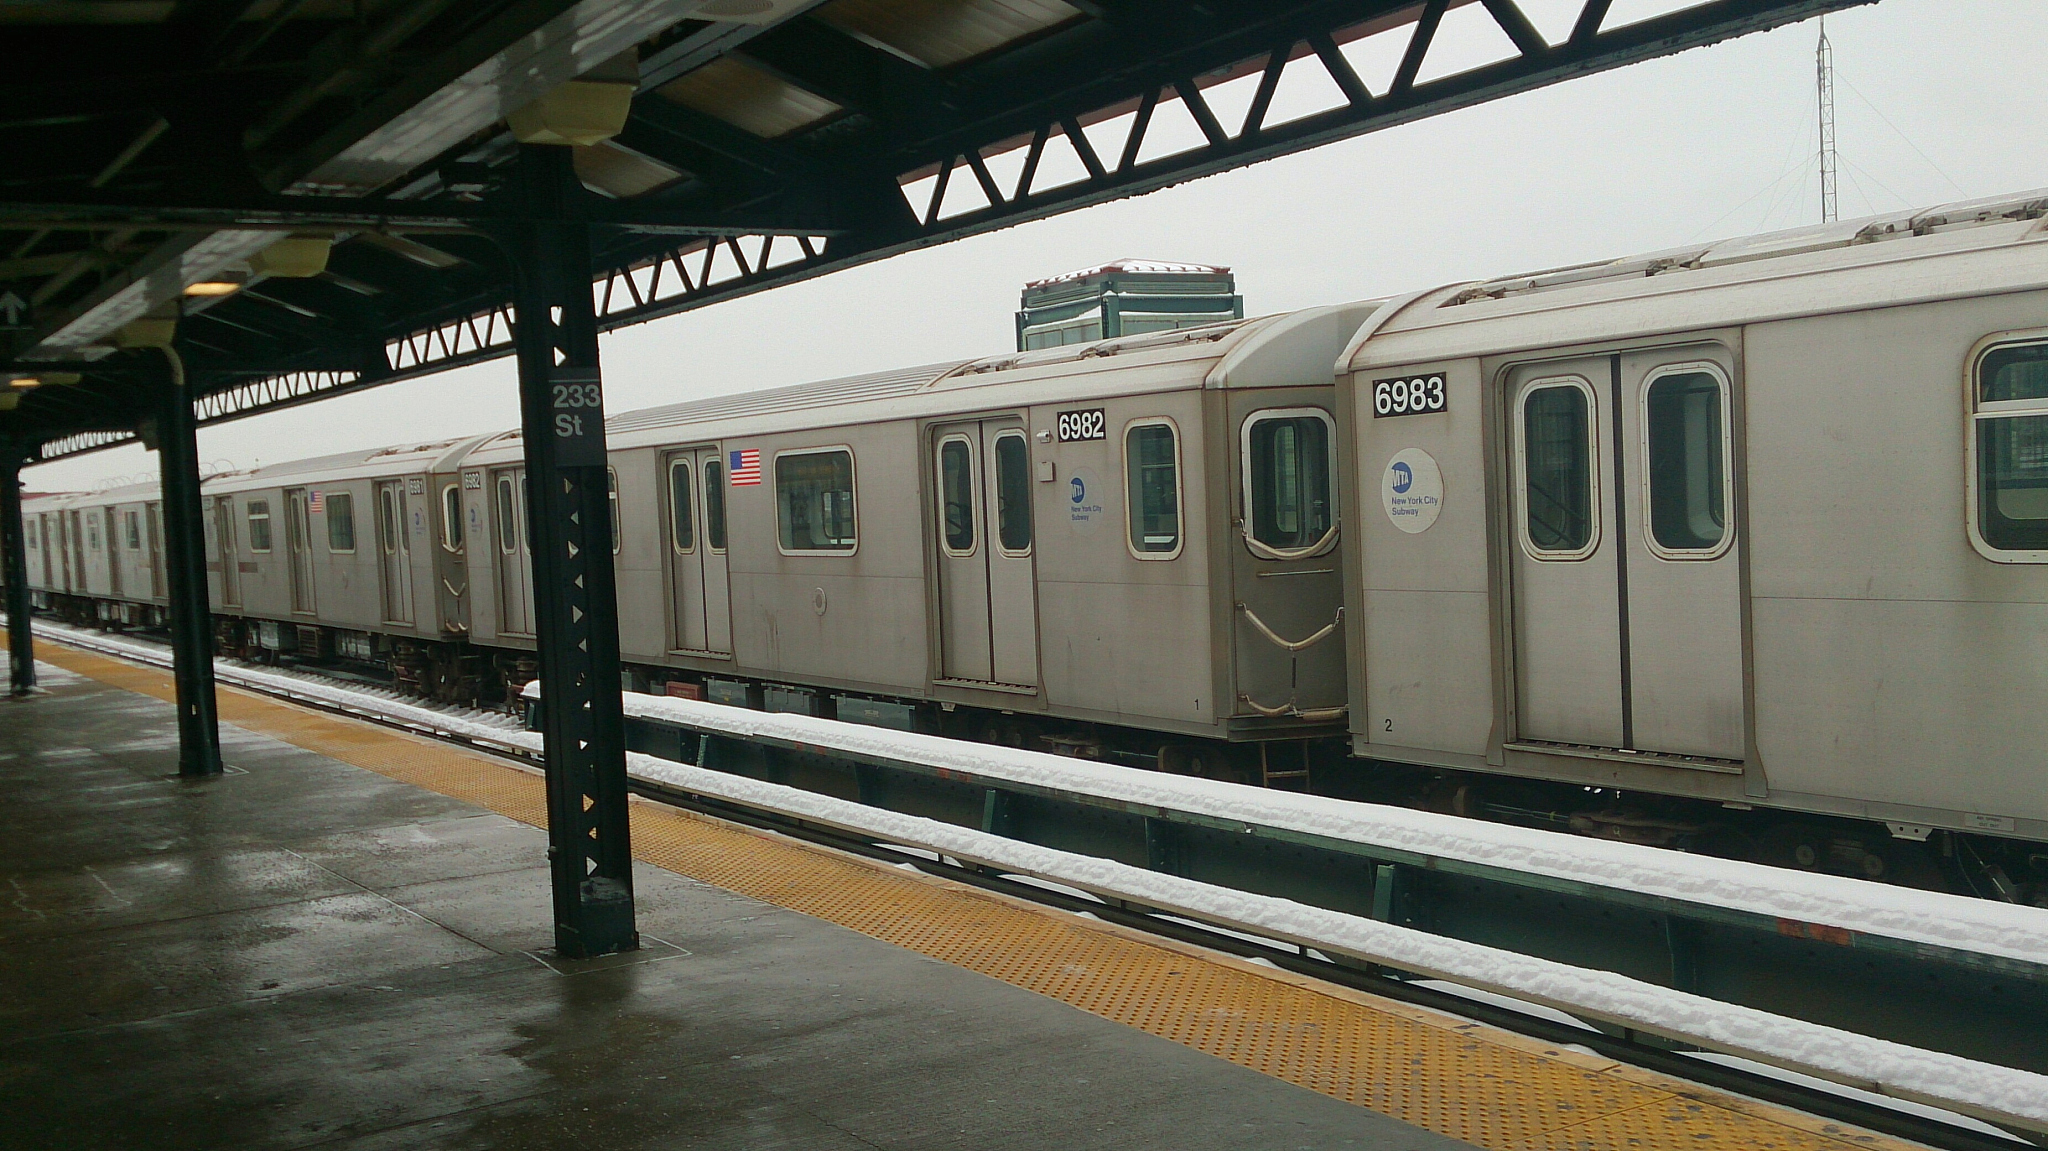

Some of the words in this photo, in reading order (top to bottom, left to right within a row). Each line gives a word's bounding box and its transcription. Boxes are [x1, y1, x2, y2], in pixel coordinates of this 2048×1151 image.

[552, 385, 601, 408] 233
[1375, 376, 1444, 414] 6983
[555, 413, 583, 437] St
[1059, 411, 1104, 440] 6982
[1391, 496, 1407, 505] New
[1408, 496, 1423, 505] York
[1424, 495, 1438, 506] City
[1093, 505, 1102, 513] City
[1392, 507, 1419, 517] Subway
[1072, 514, 1089, 522] Subway
[1194, 698, 1199, 710] 1
[1385, 718, 1393, 732] 2
